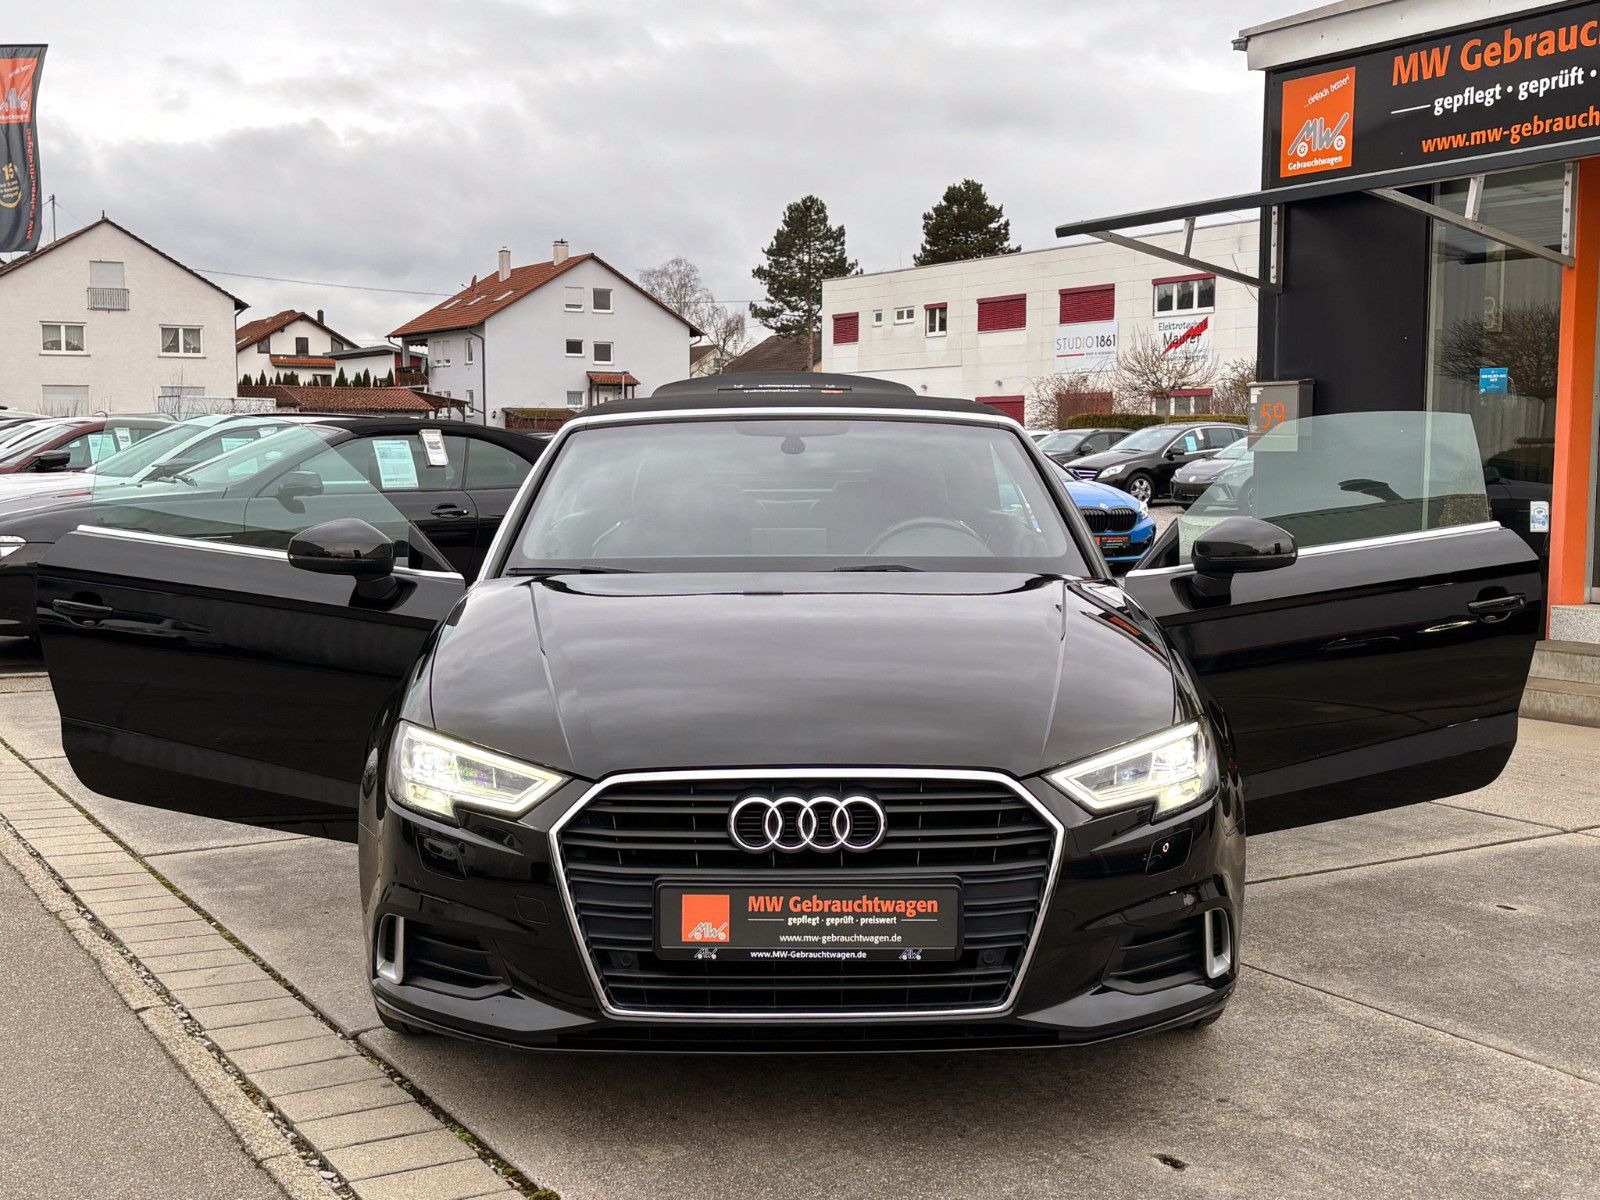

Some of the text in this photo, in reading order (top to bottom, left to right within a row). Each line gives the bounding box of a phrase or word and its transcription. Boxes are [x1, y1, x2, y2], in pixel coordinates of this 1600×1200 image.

[1392, 20, 1600, 86] MW Gebrauc
[1434, 66, 1584, 116] gepflegt geprüft
[1288, 156, 1343, 171] Gebrauchtwagen
[1261, 401, 1287, 431] 59
[748, 895, 938, 917] MW Gebrauchtwagen
[787, 915, 897, 926] gepflegt geprüft preiswert
[780, 933, 902, 945] www.mw-gebrauchtwagen.de
[750, 950, 867, 960] www.MW-Gebrauchtwagen.de
